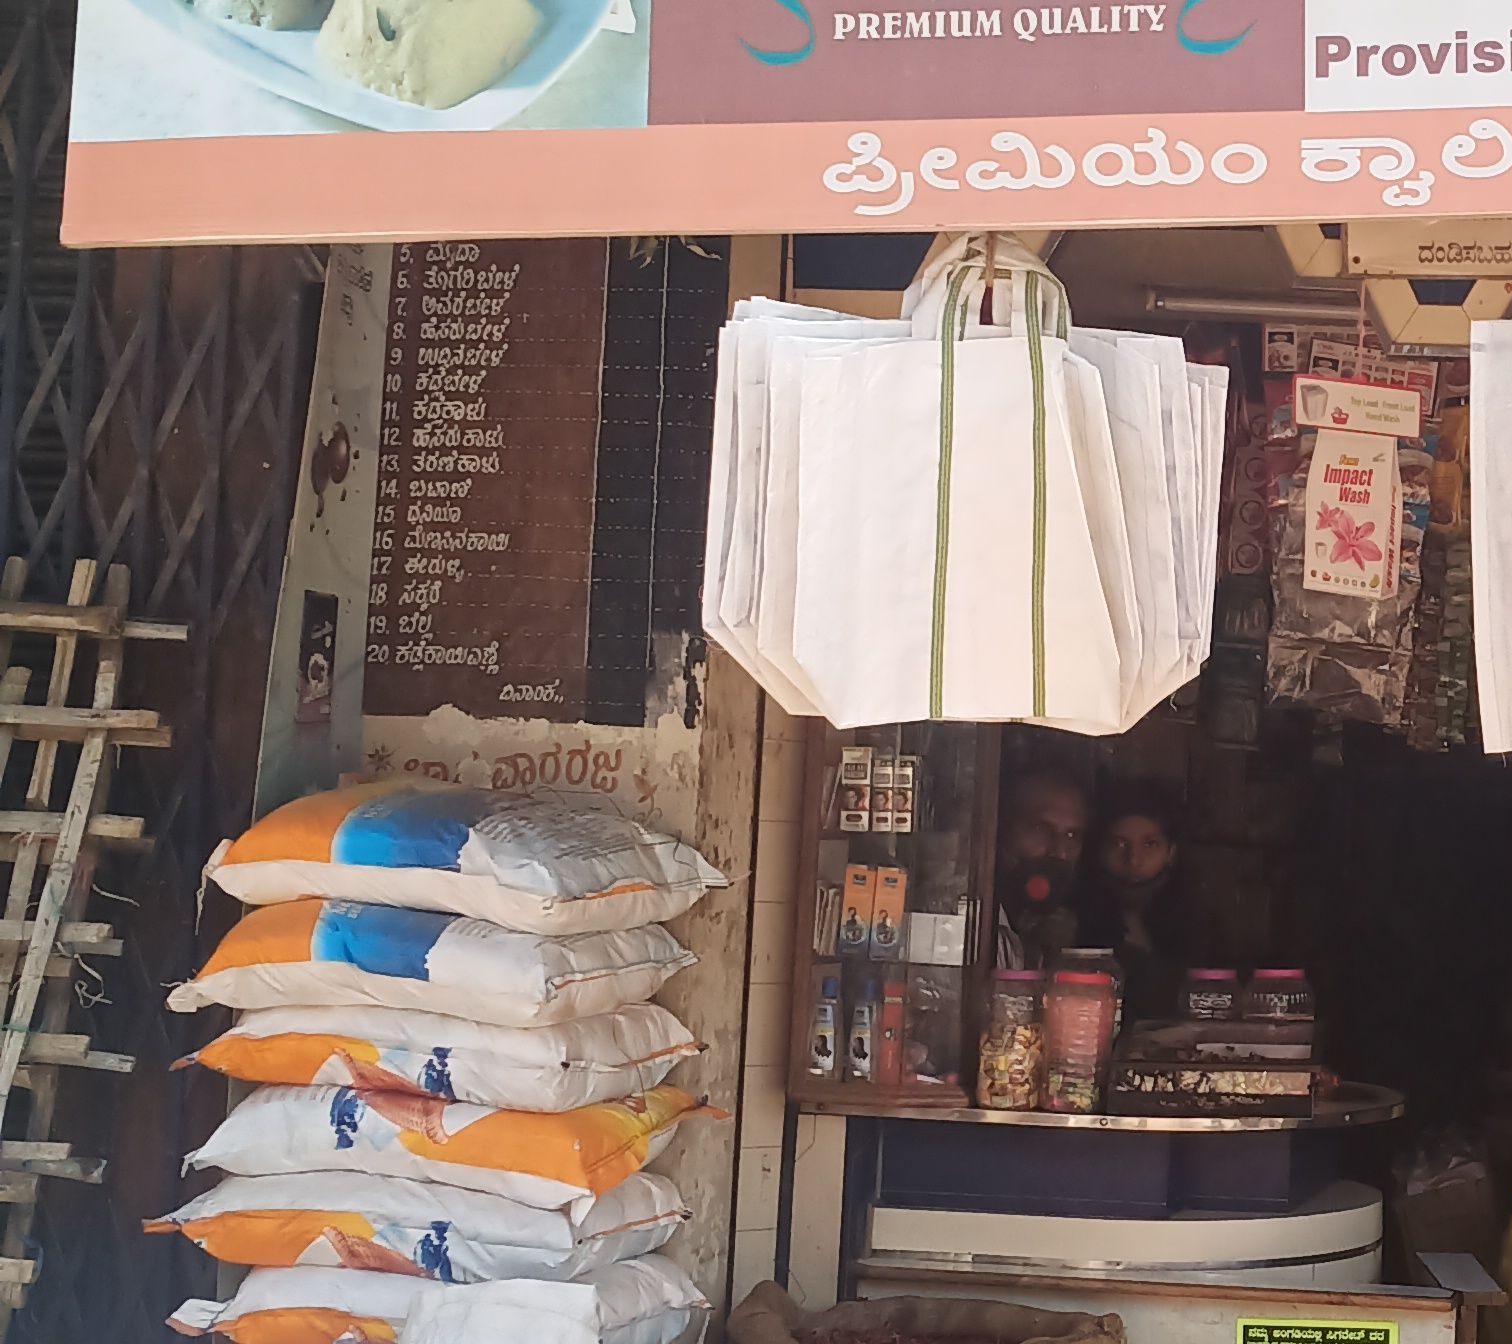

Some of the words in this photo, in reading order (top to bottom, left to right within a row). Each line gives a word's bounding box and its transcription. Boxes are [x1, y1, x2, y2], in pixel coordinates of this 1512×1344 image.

[832, 9, 1004, 41] PREMIUM
[1013, 3, 1168, 43] QUALITY
[821, 125, 1268, 217] ಪ್ರೀಮಿಯಂ
[1323, 463, 1374, 487] Impact
[1338, 486, 1371, 505] Wash
